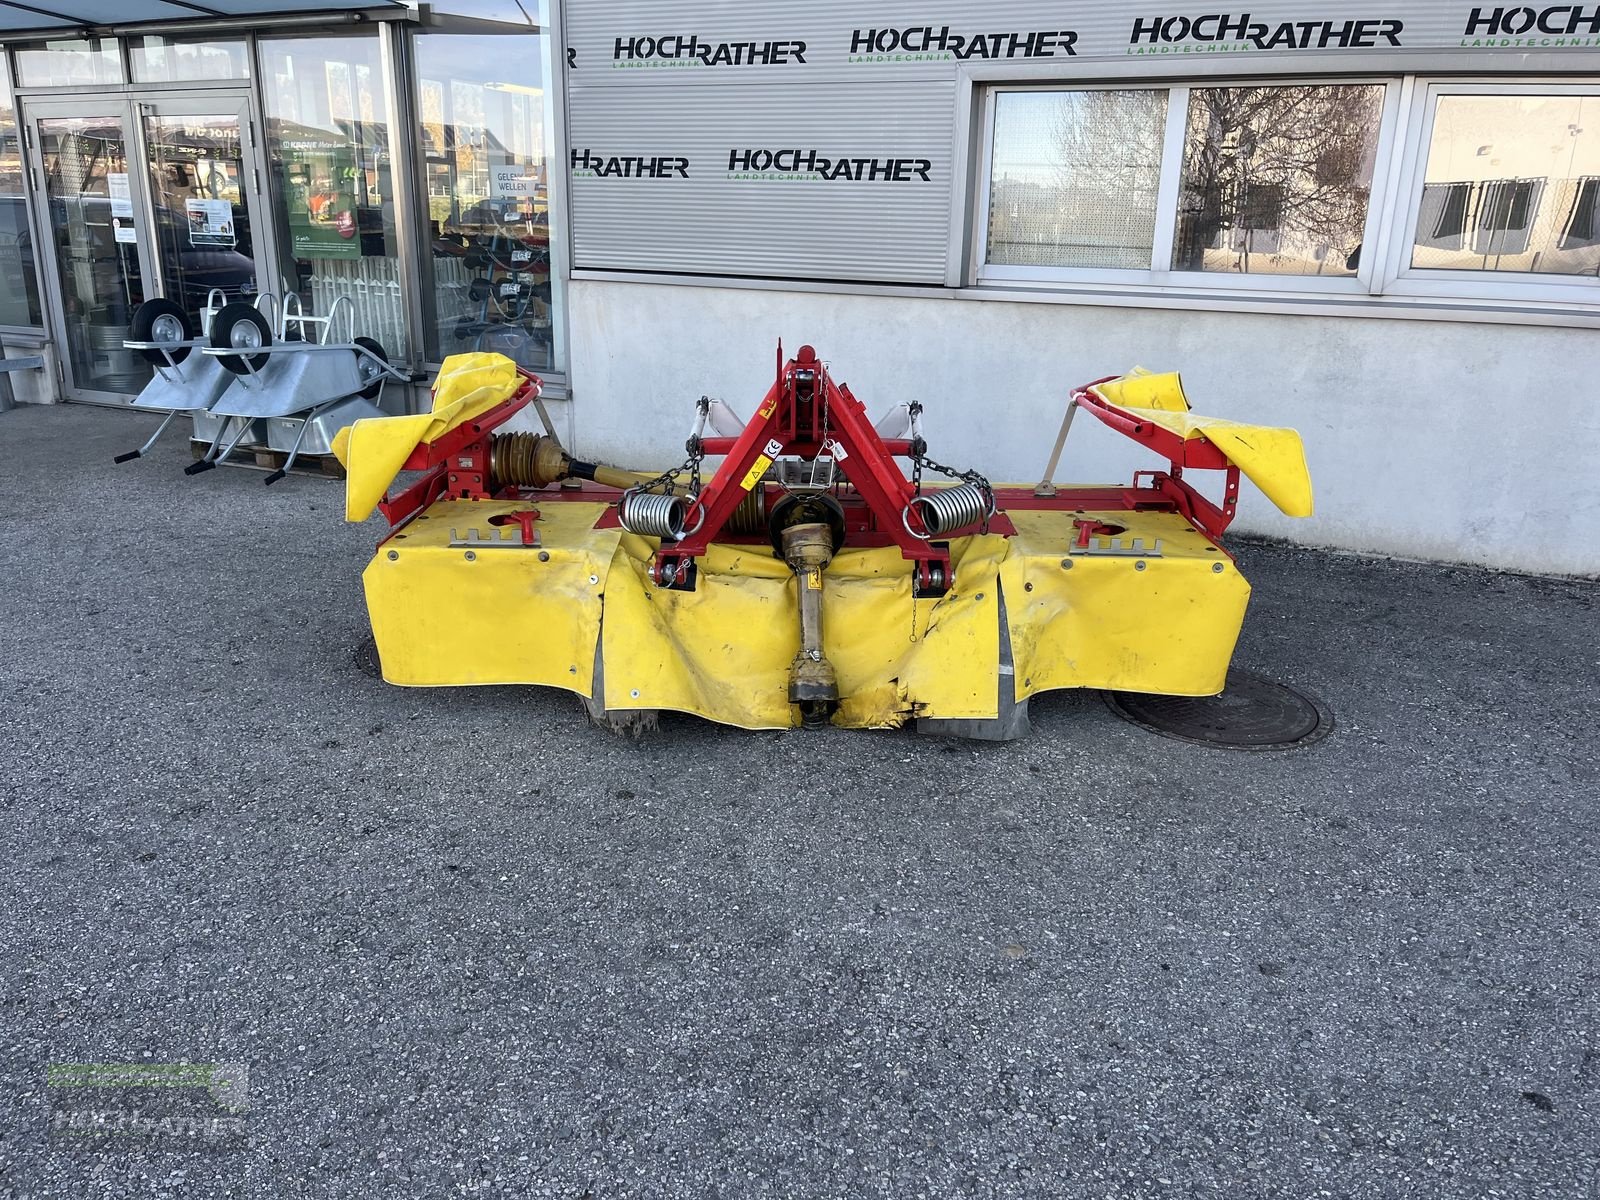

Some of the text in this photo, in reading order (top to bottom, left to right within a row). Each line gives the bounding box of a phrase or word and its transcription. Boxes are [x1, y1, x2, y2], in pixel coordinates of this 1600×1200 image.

[1130, 13, 1404, 50] HOCHRATHER
[1464, 5, 1600, 36] HOCH
[613, 35, 807, 66] HOCHRATHER
[848, 53, 951, 63] LANDTECHNIK
[850, 26, 1078, 60] HOCHRATHER
[1127, 43, 1250, 55] LANDTECHNIK
[612, 60, 701, 69] LANDTECHNIK
[571, 149, 690, 179] HRATHER
[727, 173, 818, 181] LANDTECHNIK
[728, 149, 932, 182] HOCHRATHER
[498, 182, 527, 191] WELLEN
